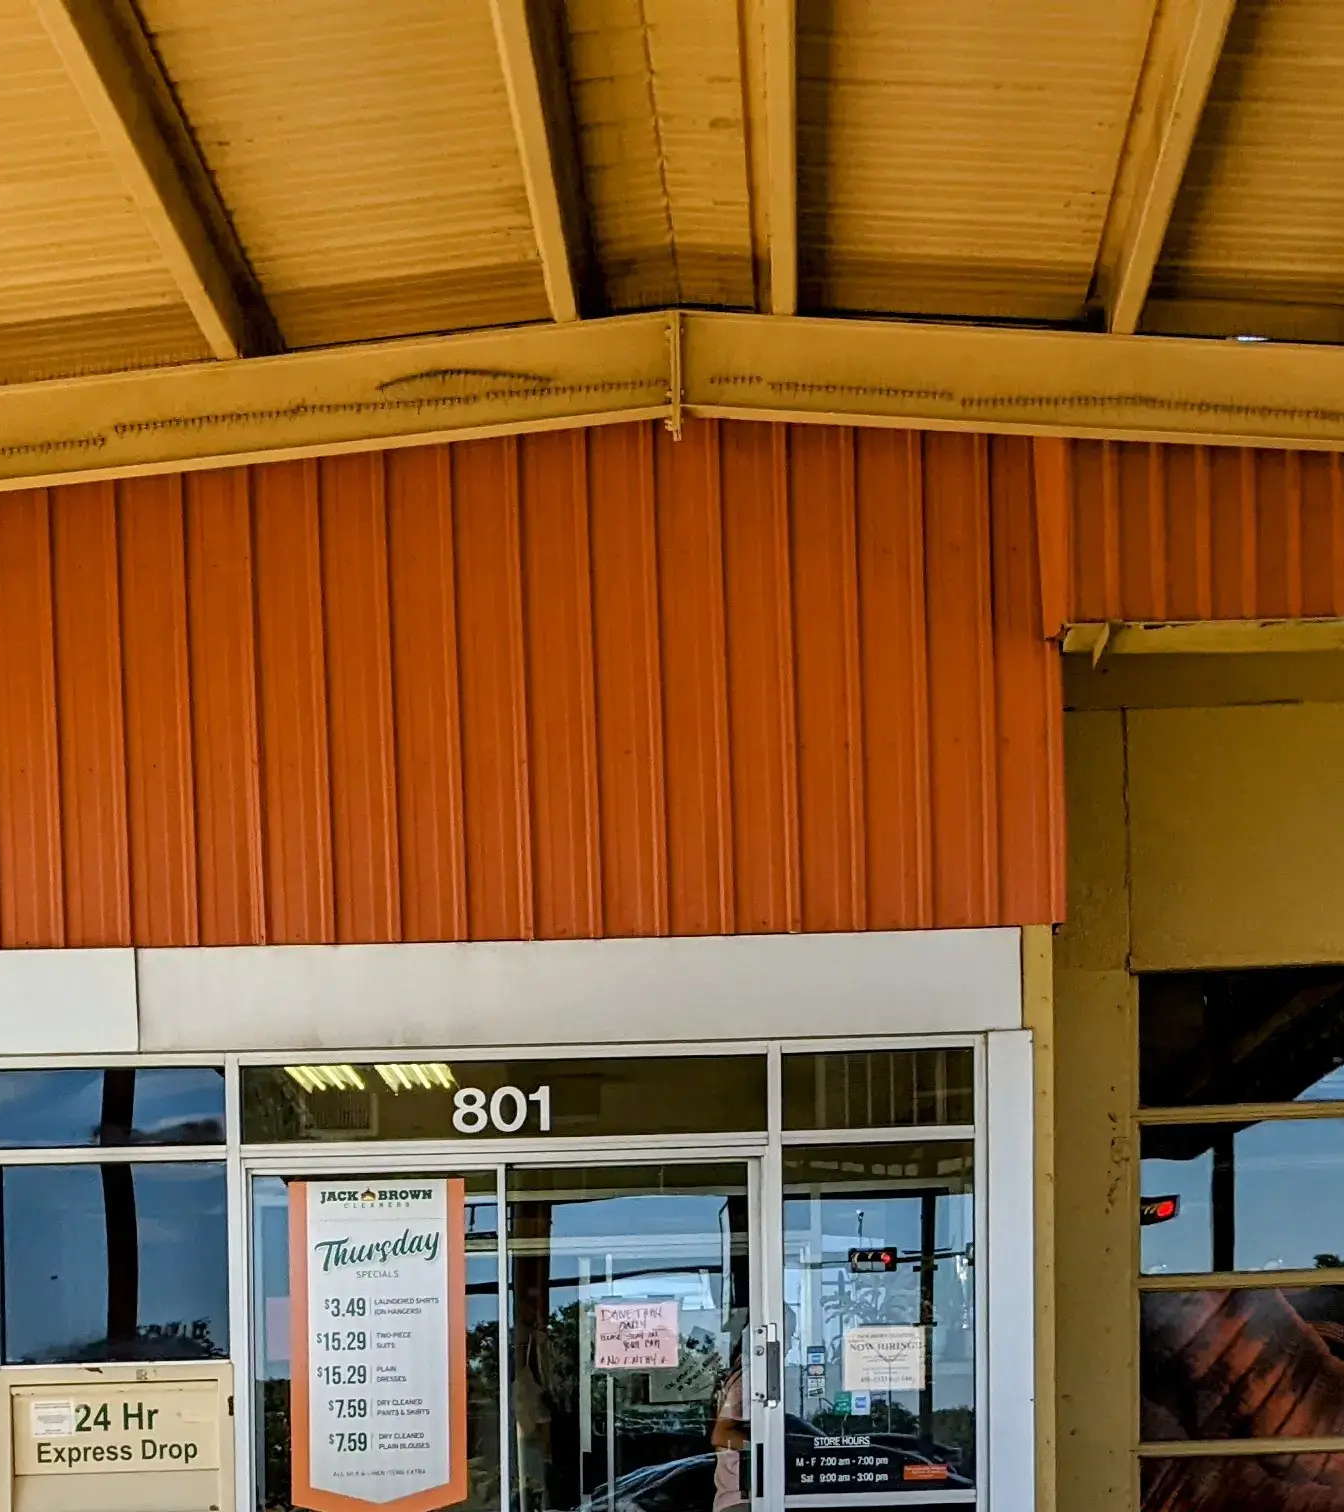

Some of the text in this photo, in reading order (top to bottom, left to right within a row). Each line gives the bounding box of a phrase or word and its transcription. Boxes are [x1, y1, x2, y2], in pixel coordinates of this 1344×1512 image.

[452, 1085, 552, 1134] 801
[320, 1189, 433, 1204] JACK BROWN
[314, 1228, 440, 1272] Thursday
[356, 1270, 399, 1279] SPECIALS
[324, 1297, 366, 1317] $3.49
[316, 1331, 367, 1351] $15.29
[850, 1342, 874, 1351] NOW
[316, 1365, 367, 1385] $15.29
[74, 1403, 111, 1432] 24
[123, 1402, 159, 1430] Hr
[328, 1399, 367, 1418] $7.59
[328, 1432, 367, 1452] $7.59
[814, 1435, 870, 1446] STORE HOURS
[37, 1439, 198, 1468] Express Drop
[820, 1457, 837, 1466] 7:00
[857, 1456, 874, 1465] 7:00
[800, 1474, 814, 1483] Sat
